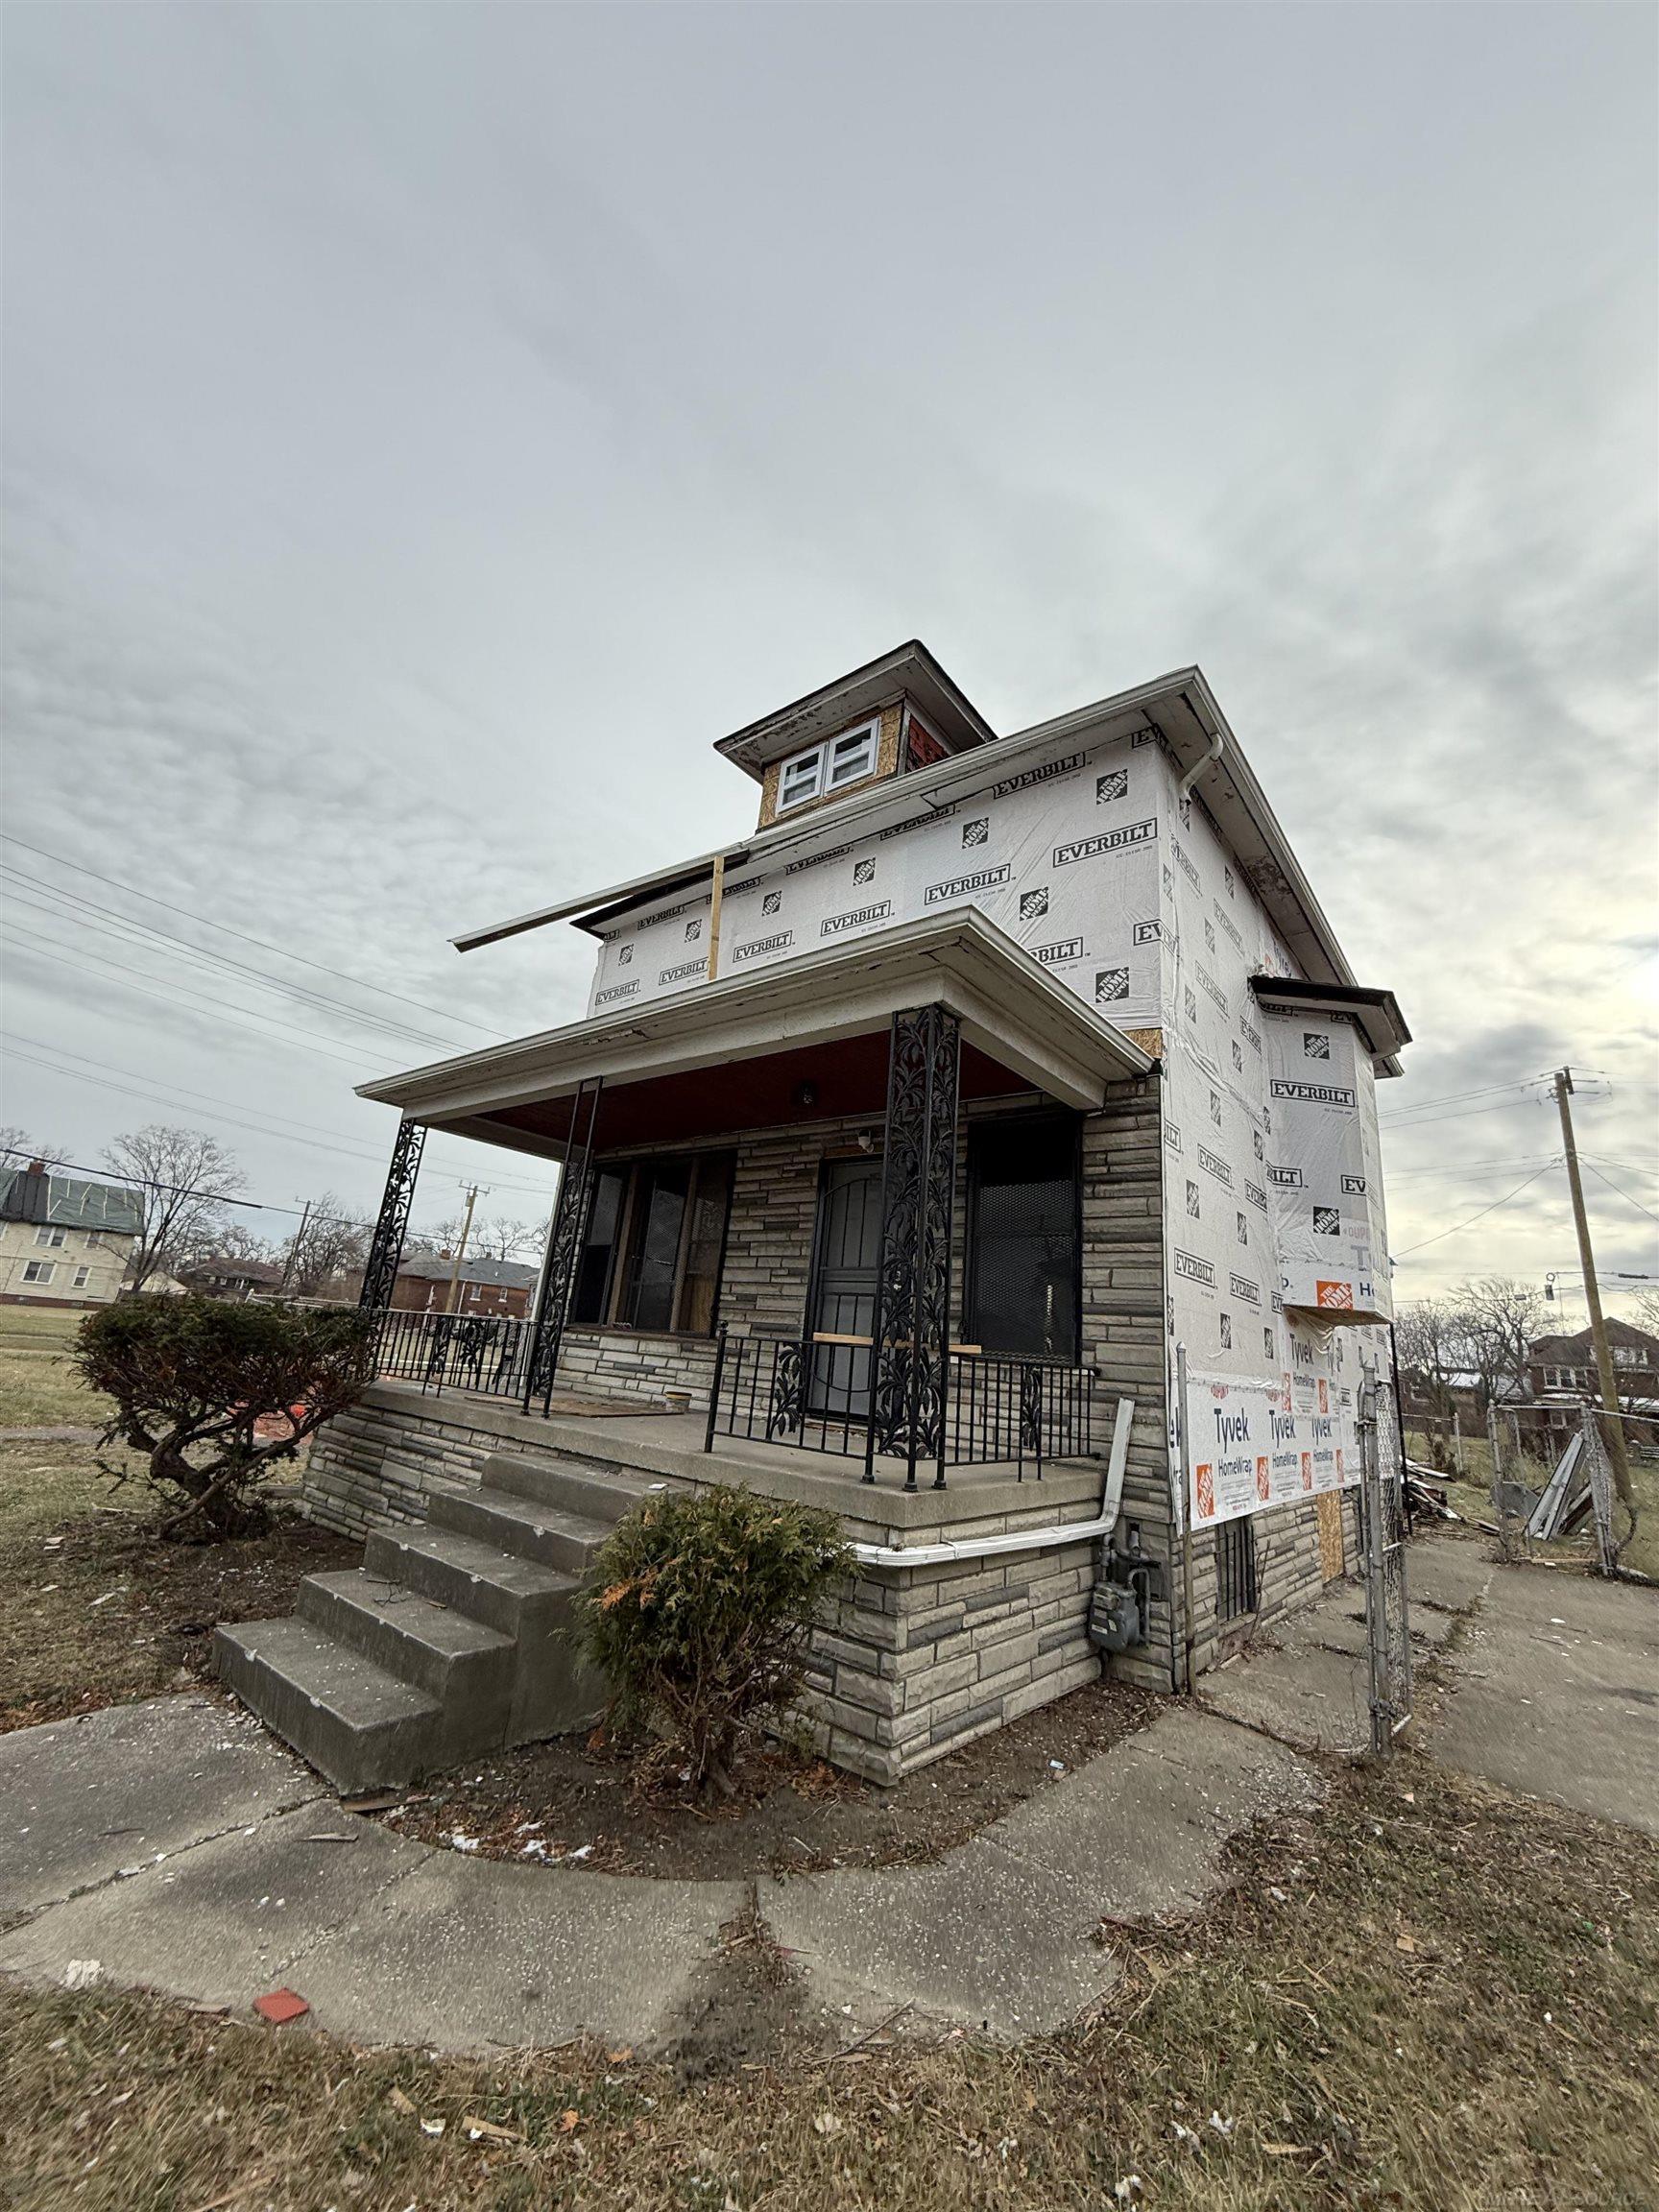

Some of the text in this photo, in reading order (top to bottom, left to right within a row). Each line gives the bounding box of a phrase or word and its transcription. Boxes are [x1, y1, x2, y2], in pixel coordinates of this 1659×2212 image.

[996, 754, 1083, 796] EVERBILT
[1096, 771, 1127, 803] HOME
[1056, 821, 1153, 864] EVERBILT
[927, 867, 1007, 902] EVERBILT
[824, 903, 889, 934] EVERBILT
[735, 933, 789, 959] EVERBILT
[661, 959, 708, 983] EVERBILT
[1095, 968, 1128, 1001] HOME
[597, 981, 637, 1003] EVERBILT
[1273, 1082, 1352, 1104] EVERBILT
[1313, 1209, 1338, 1233] HOME
[1176, 1253, 1214, 1284] EVERBILT
[1214, 1407, 1250, 1454] Tyvek
[1269, 1409, 1296, 1449] Tyvek
